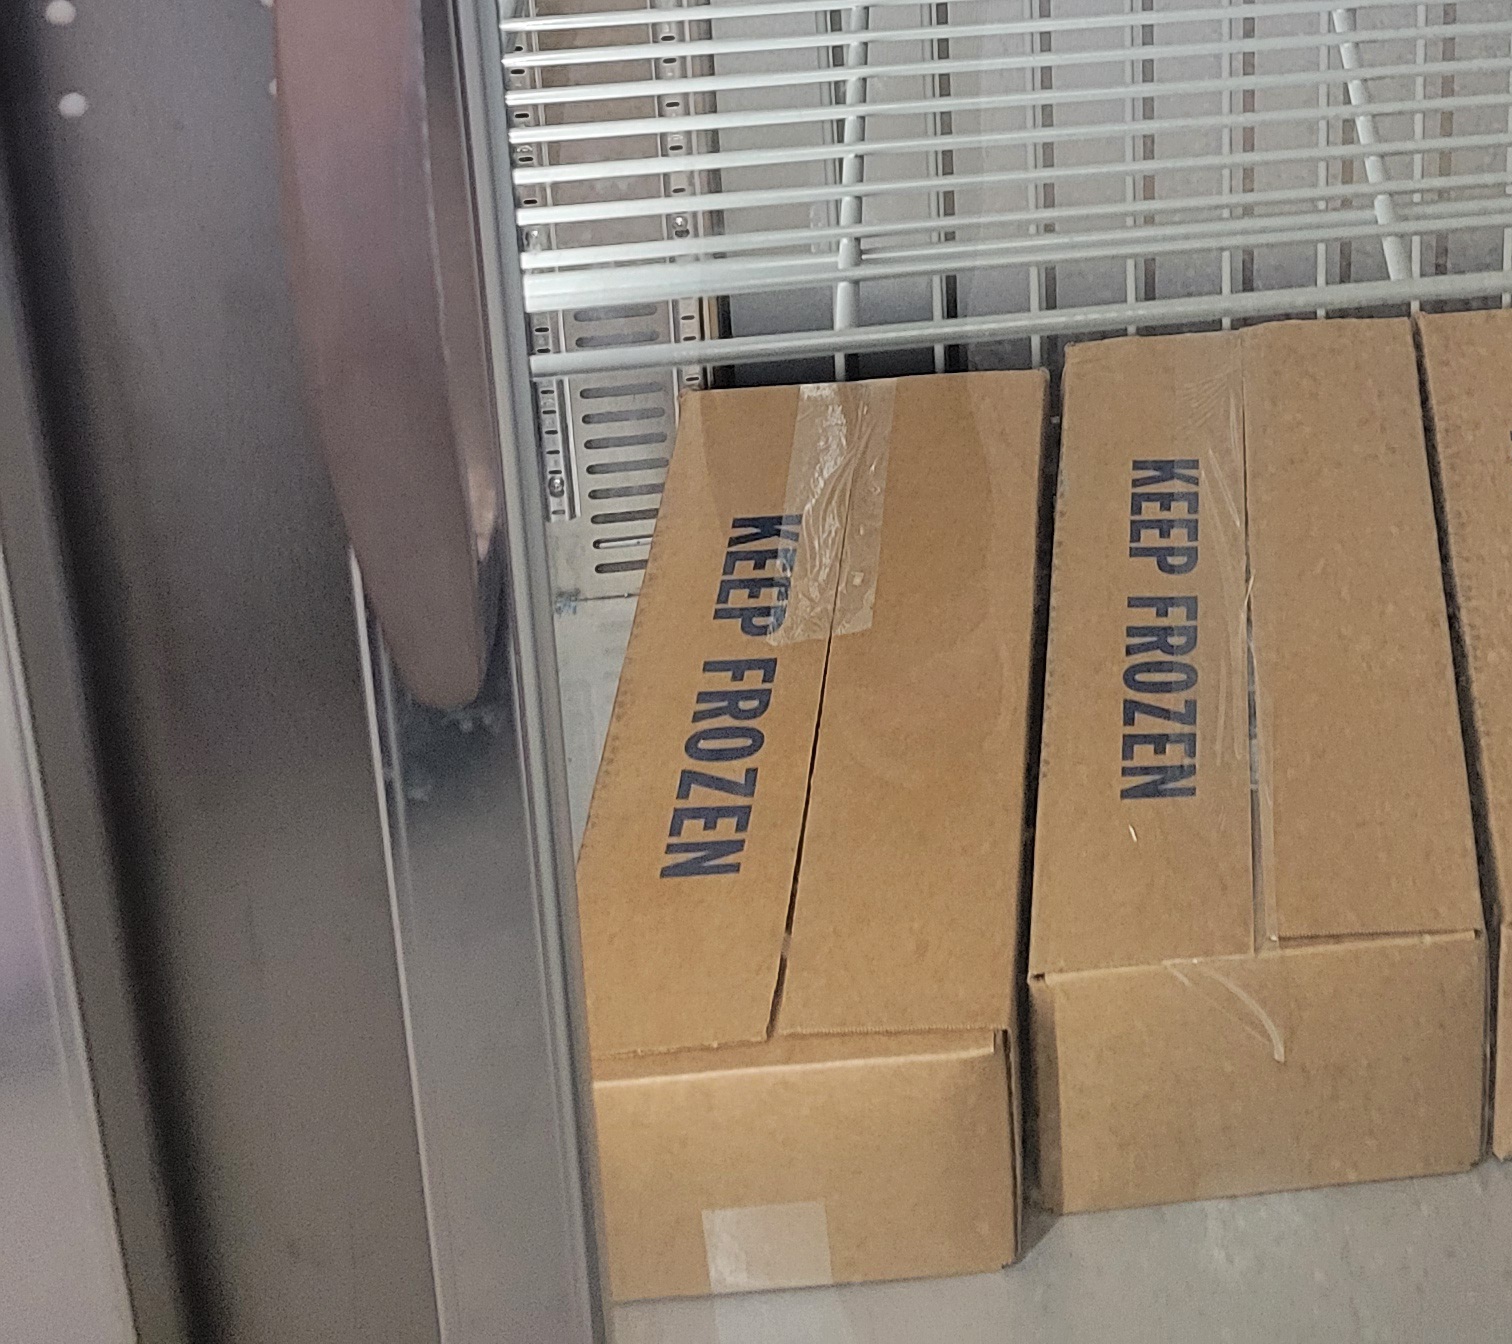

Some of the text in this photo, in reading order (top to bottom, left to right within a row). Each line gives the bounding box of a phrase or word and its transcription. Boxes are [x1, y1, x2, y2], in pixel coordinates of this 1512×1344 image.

[659, 514, 803, 880] KEEP FROZEN
[1120, 458, 1200, 801] KEEP FROZEN
